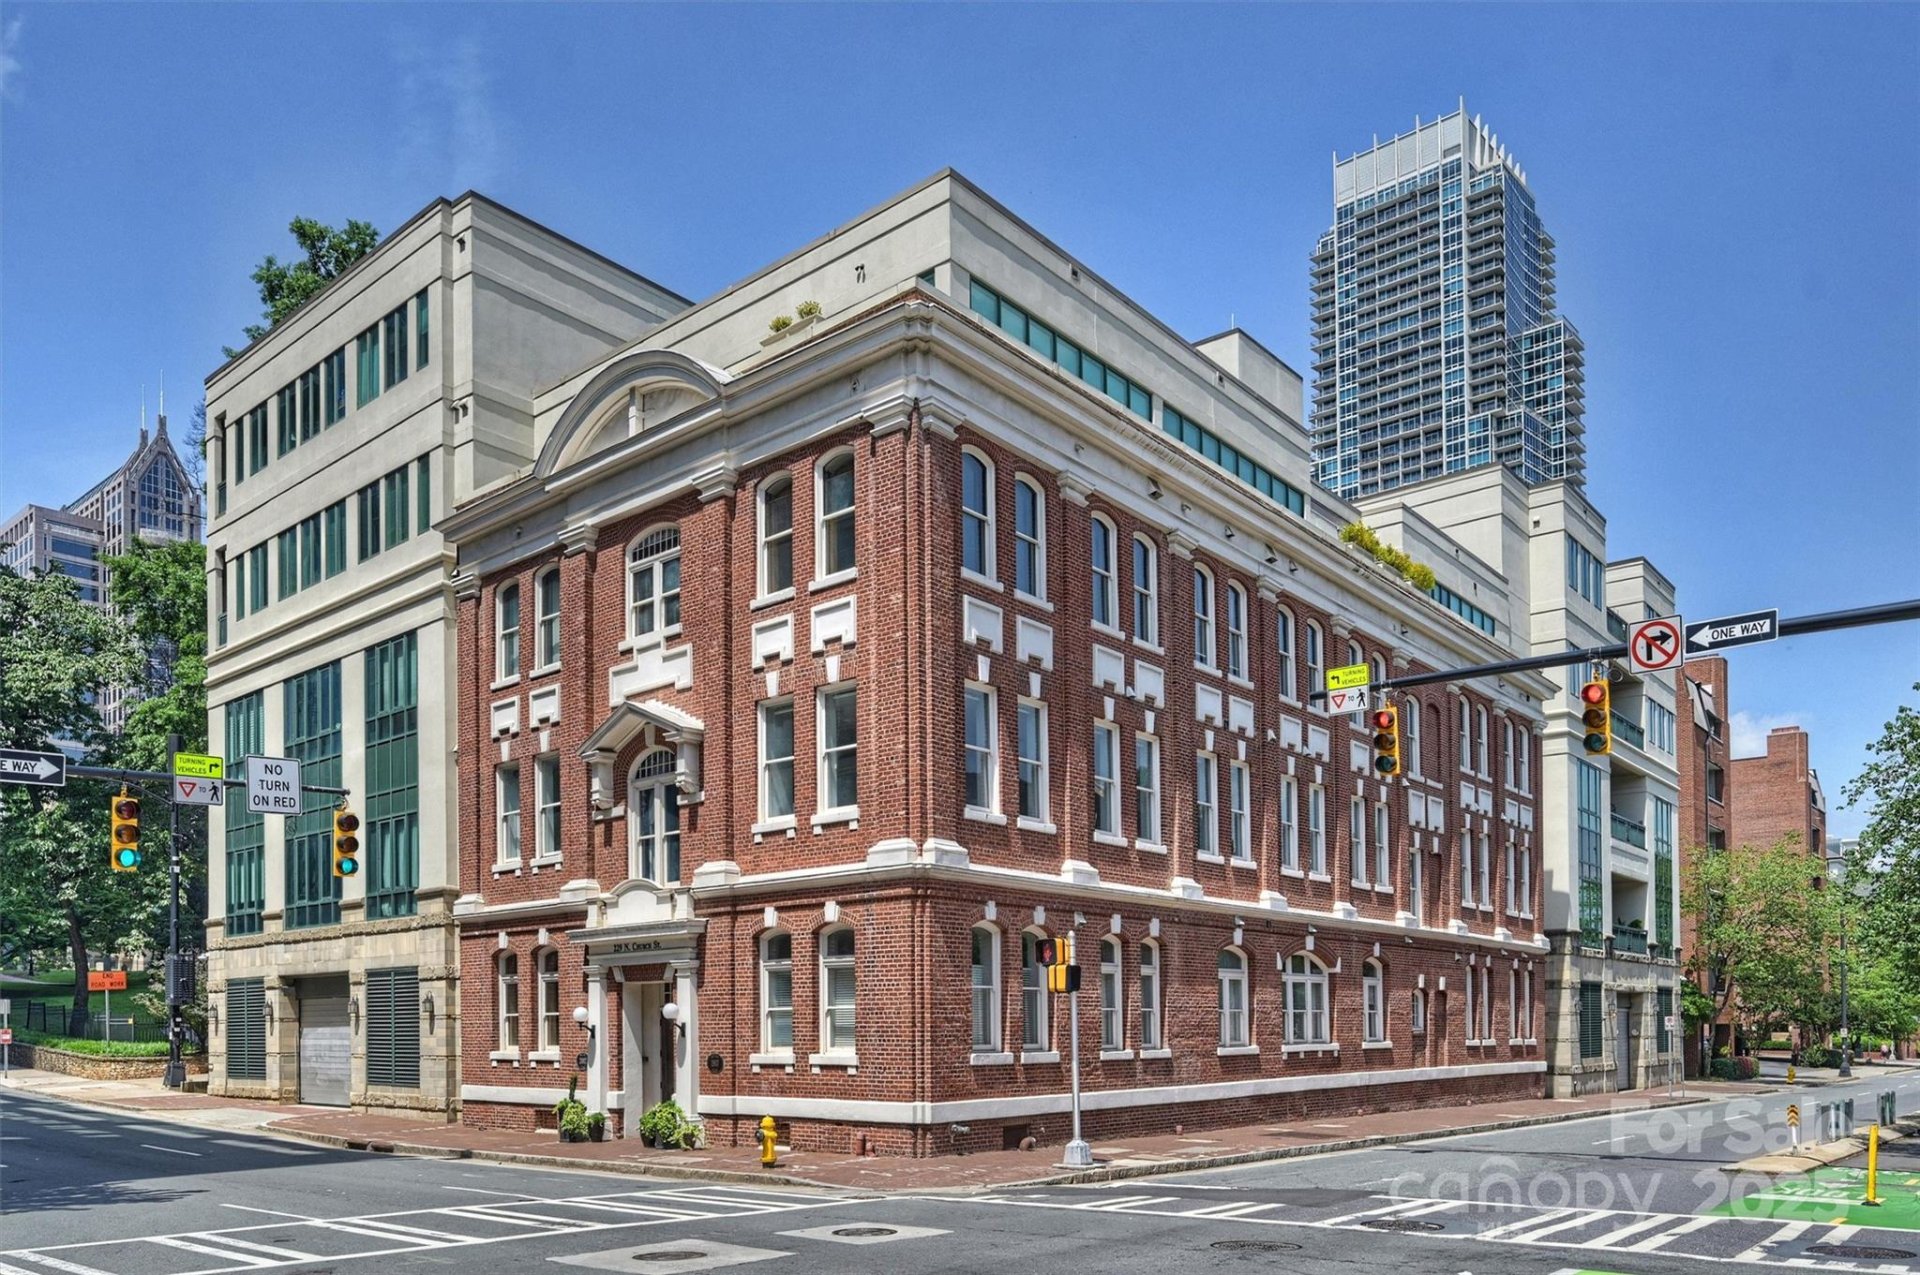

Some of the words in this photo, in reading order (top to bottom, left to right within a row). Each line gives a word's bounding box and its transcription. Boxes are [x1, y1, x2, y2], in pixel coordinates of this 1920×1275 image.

[1711, 626, 1736, 640] ONE
[1740, 621, 1766, 635] WAY
[1341, 676, 1367, 685] VEHICLES
[12, 760, 37, 773] WAY
[179, 757, 206, 765] TURNING
[177, 766, 207, 774] VEHICLES
[264, 764, 283, 775] NO
[259, 779, 290, 792] TURN
[253, 794, 269, 806] ON
[274, 796, 296, 808] RED
